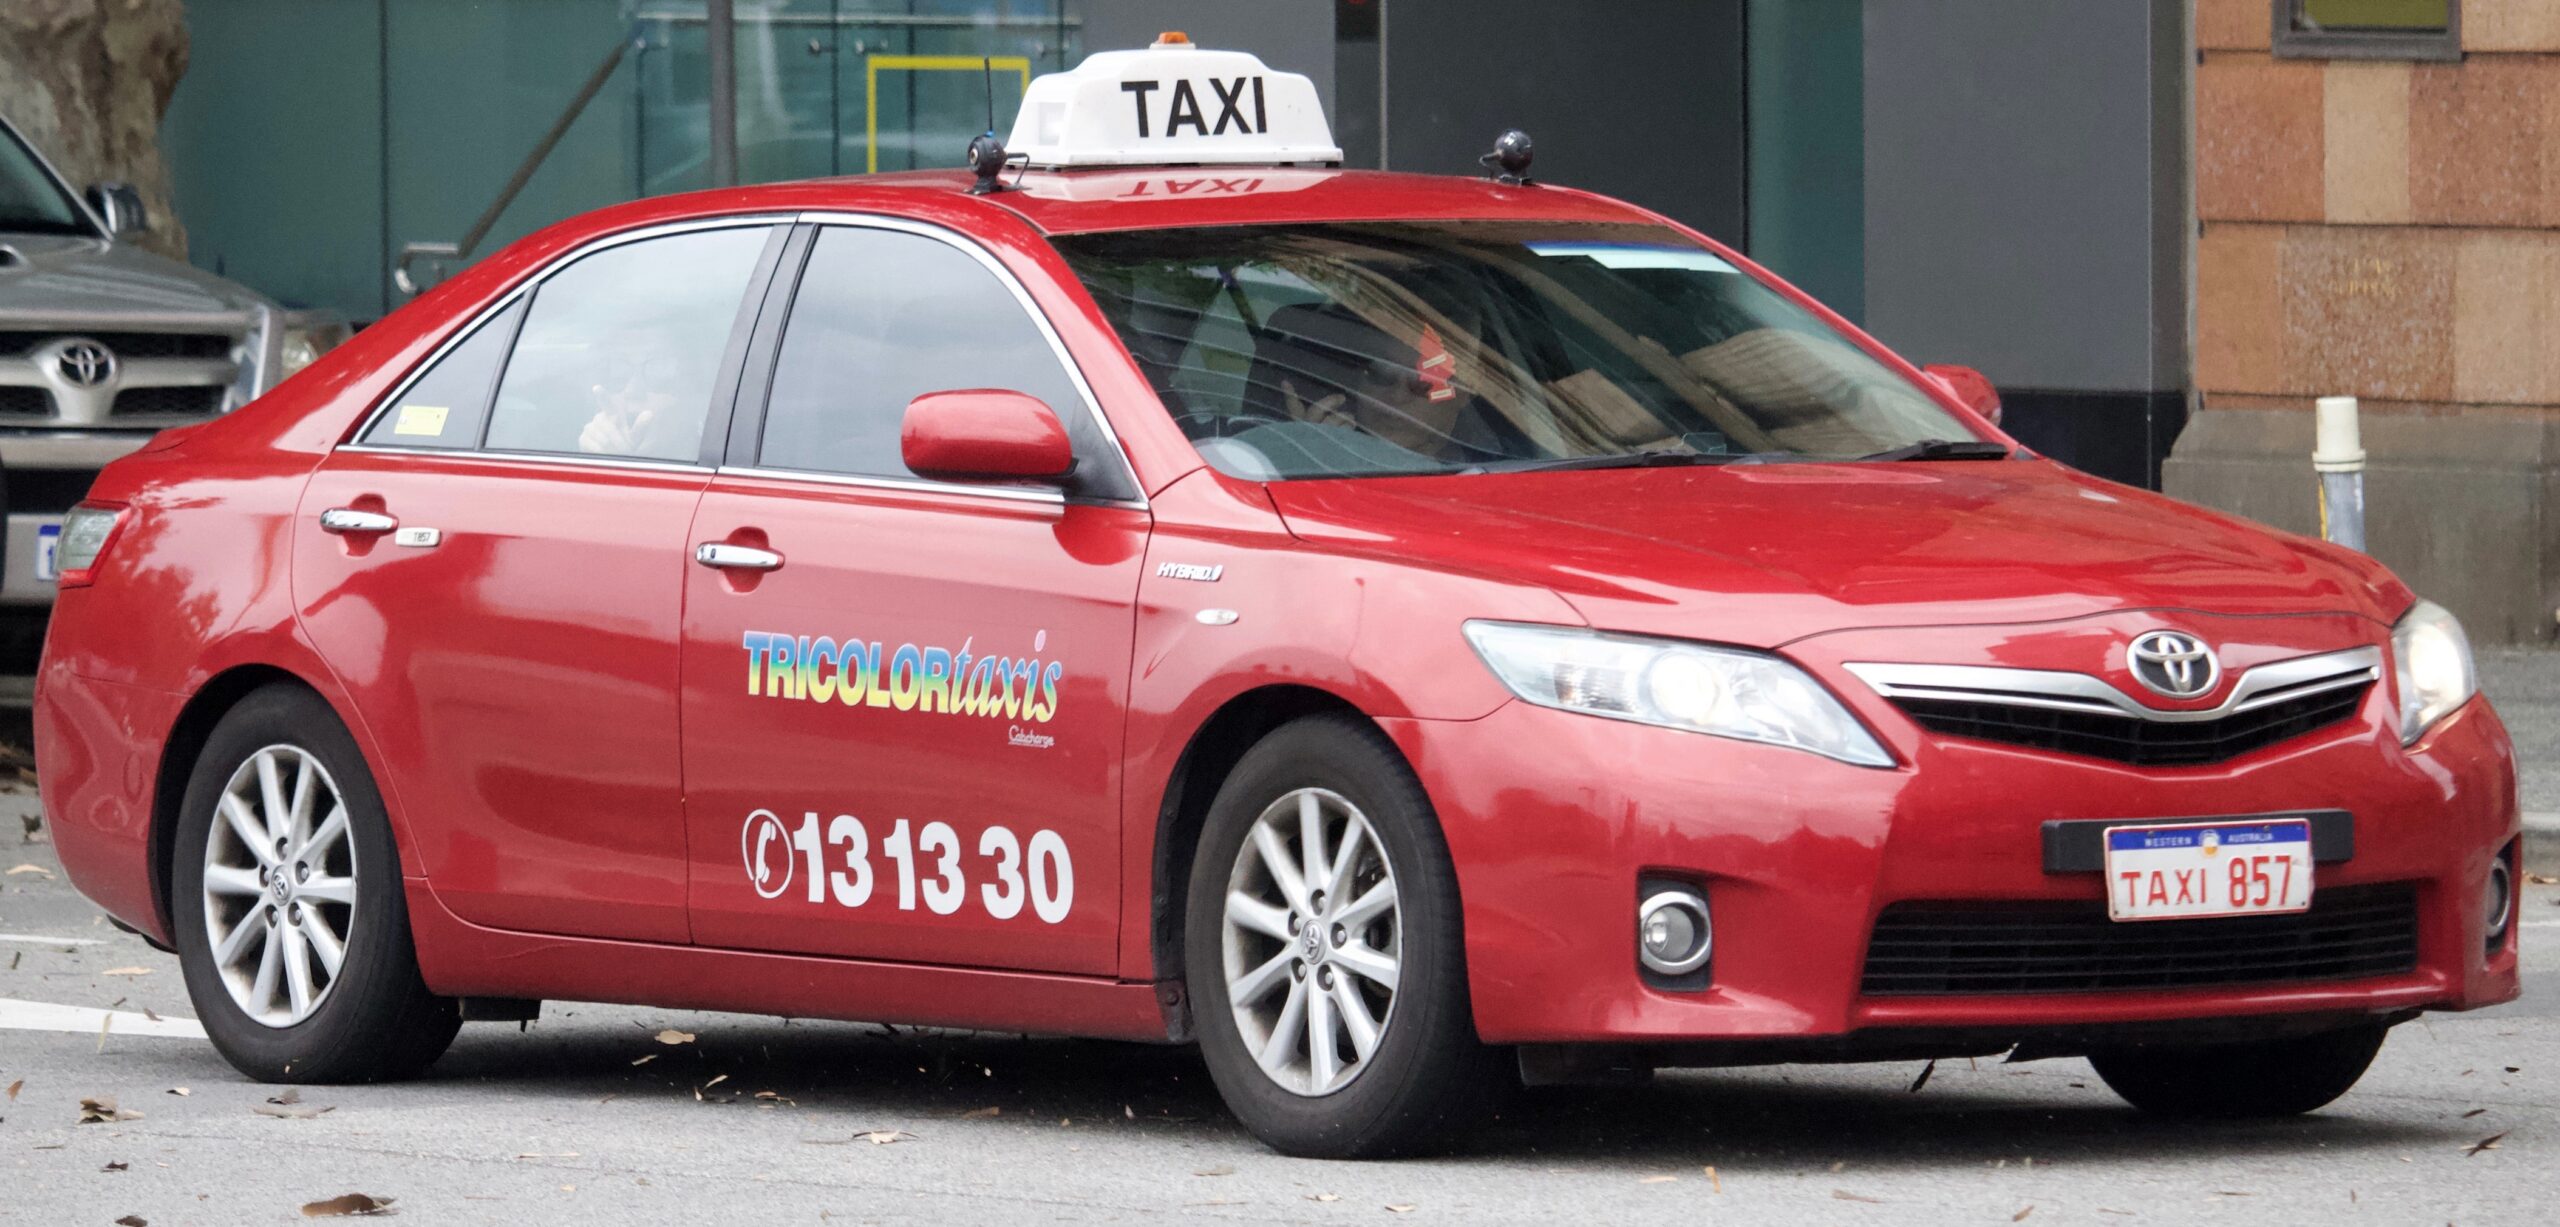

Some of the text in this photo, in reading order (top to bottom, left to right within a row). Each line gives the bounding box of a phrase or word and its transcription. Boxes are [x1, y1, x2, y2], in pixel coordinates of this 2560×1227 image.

[1121, 76, 1268, 138] TAXI
[1157, 562, 1214, 581] HYBRID
[1008, 724, 1055, 748] Cabcharge
[2144, 832, 2274, 847] WESTERN AUSTRALIA
[793, 812, 1074, 925] 13 13 30
[2120, 855, 2292, 908] TAXI 857
